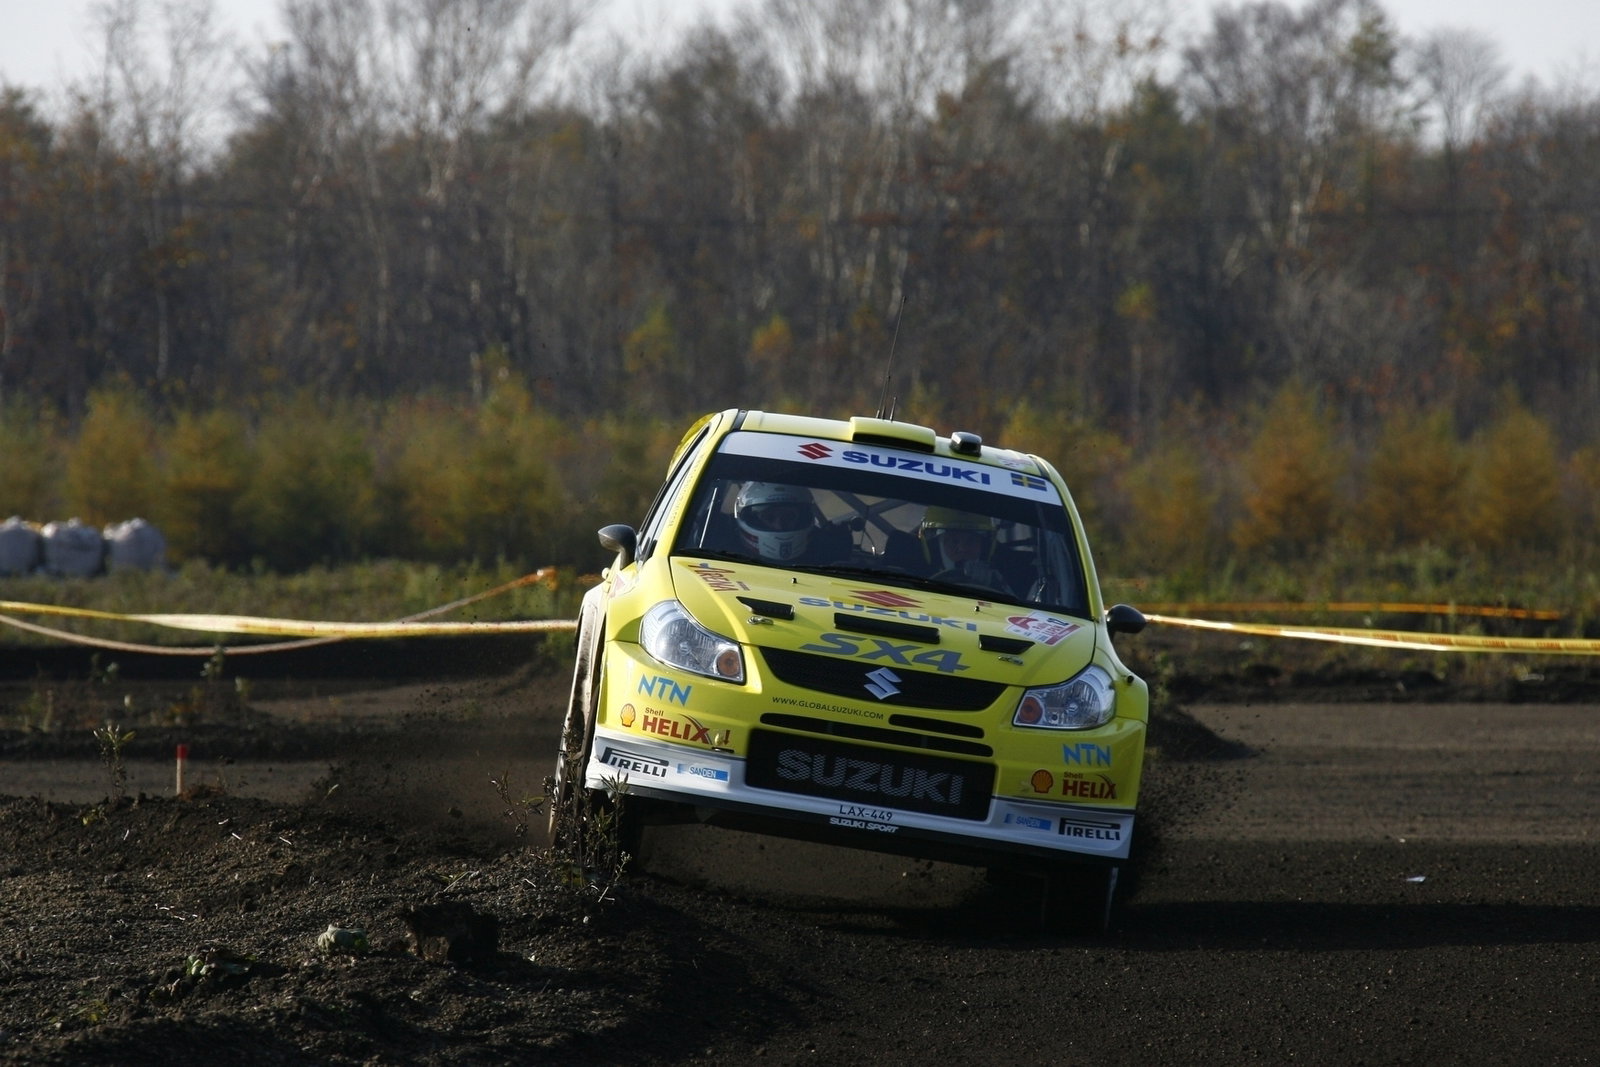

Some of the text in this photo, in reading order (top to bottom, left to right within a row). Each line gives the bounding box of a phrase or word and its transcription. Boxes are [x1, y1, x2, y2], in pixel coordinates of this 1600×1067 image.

[842, 450, 990, 485] SUZUKI
[798, 596, 977, 632] SUZUKI
[798, 632, 970, 674] SX4
[638, 674, 692, 706] NTN
[645, 707, 664, 717] Shell
[772, 696, 884, 720] WWW.GLOBALSUZUKI.COM
[642, 713, 713, 746] HELIX
[600, 747, 669, 778] PIRELLI
[1062, 743, 1112, 767] NTN
[689, 766, 717, 779] SANDEN
[776, 749, 964, 806] SUZUKI
[1063, 771, 1084, 779] Shell
[1062, 774, 1117, 799] HELIX
[829, 816, 899, 833] SUZUKI SPORT
[840, 805, 893, 821] LAX-449
[1058, 817, 1121, 841] PIRELLI
